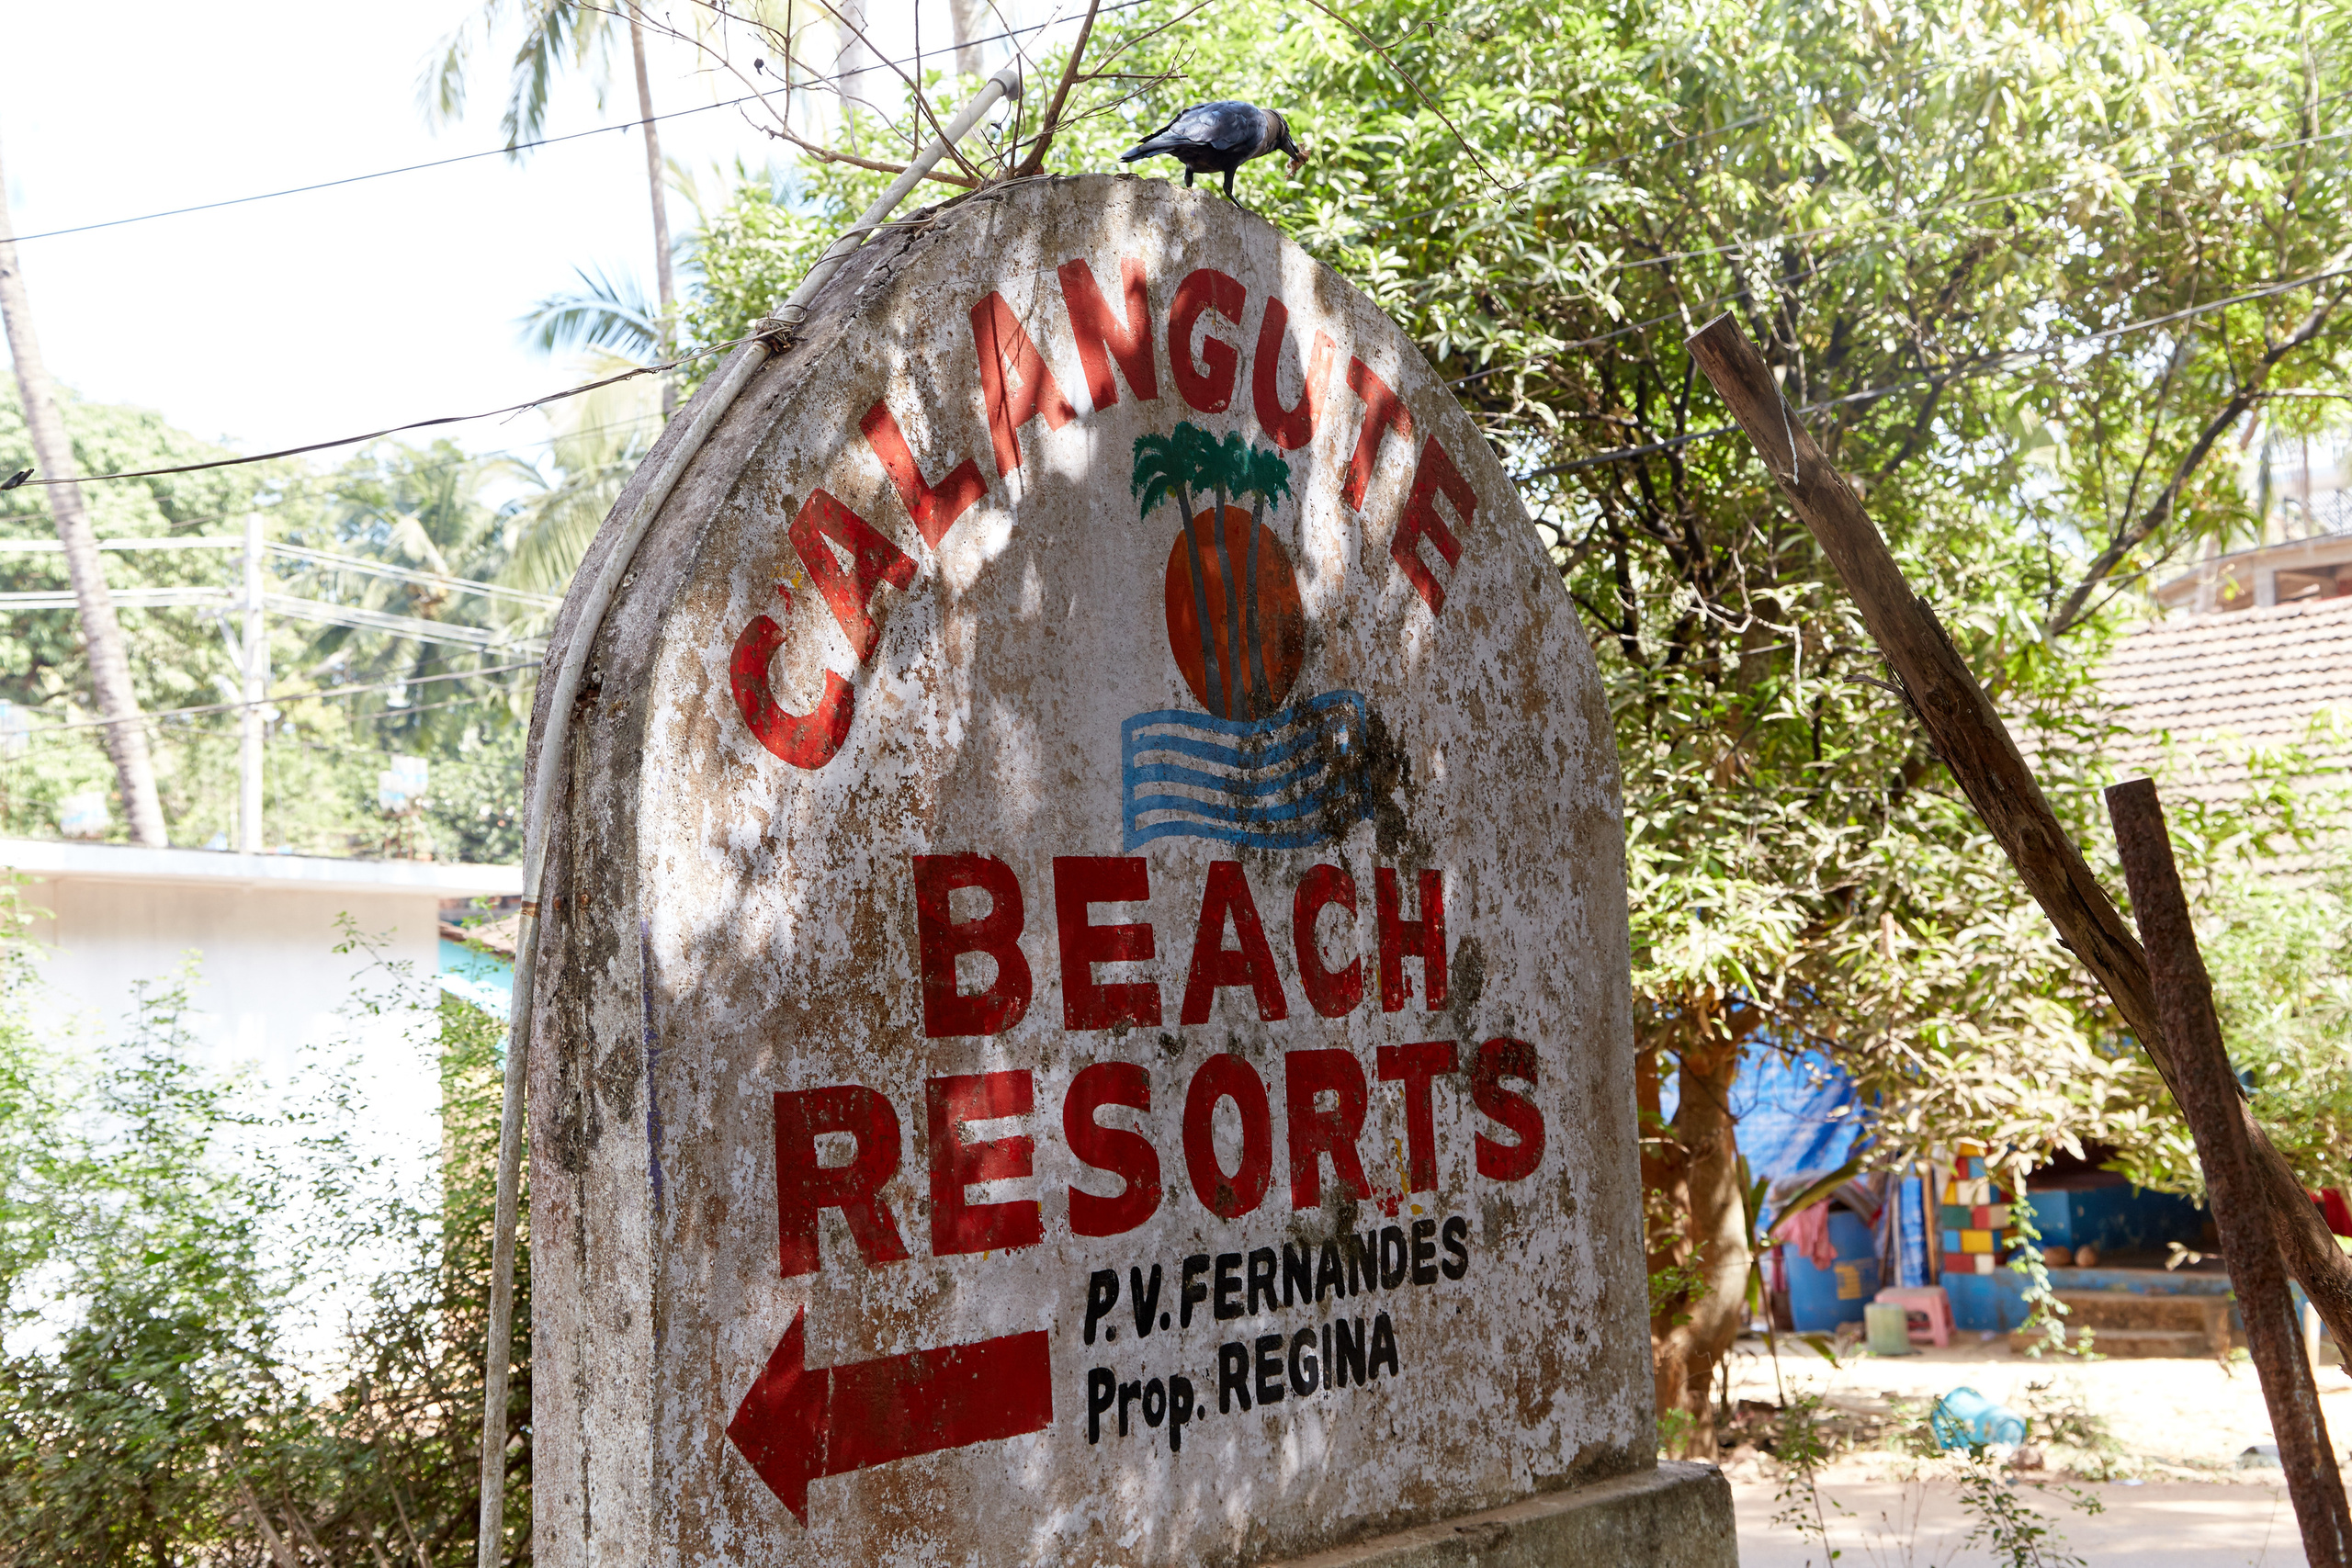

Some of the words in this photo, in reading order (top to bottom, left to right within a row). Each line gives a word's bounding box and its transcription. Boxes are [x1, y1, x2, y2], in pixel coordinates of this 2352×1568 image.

[729, 257, 1477, 769] CALANGUTE
[913, 852, 1448, 1039] BEACH
[773, 1038, 1546, 1280] RESORTS
[1088, 1367, 1205, 1451] Prop.
[1218, 1311, 1398, 1414] REGINA
